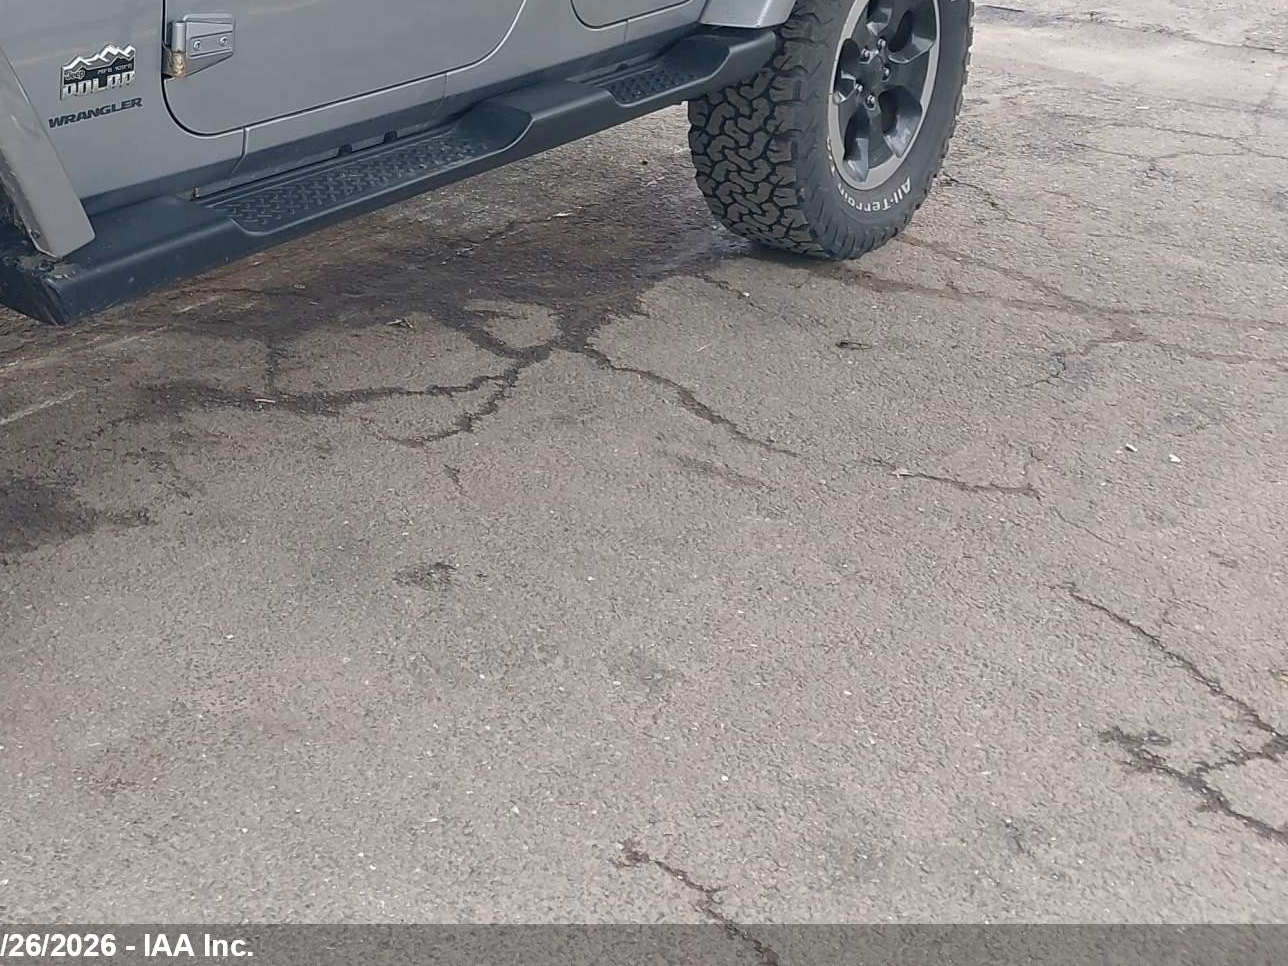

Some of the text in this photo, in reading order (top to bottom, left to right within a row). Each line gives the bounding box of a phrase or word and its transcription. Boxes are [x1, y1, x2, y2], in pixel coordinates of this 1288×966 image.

[64, 69, 86, 81] Jeep
[48, 97, 144, 129] WRANGLER
[837, 176, 912, 212] All-Terrain
